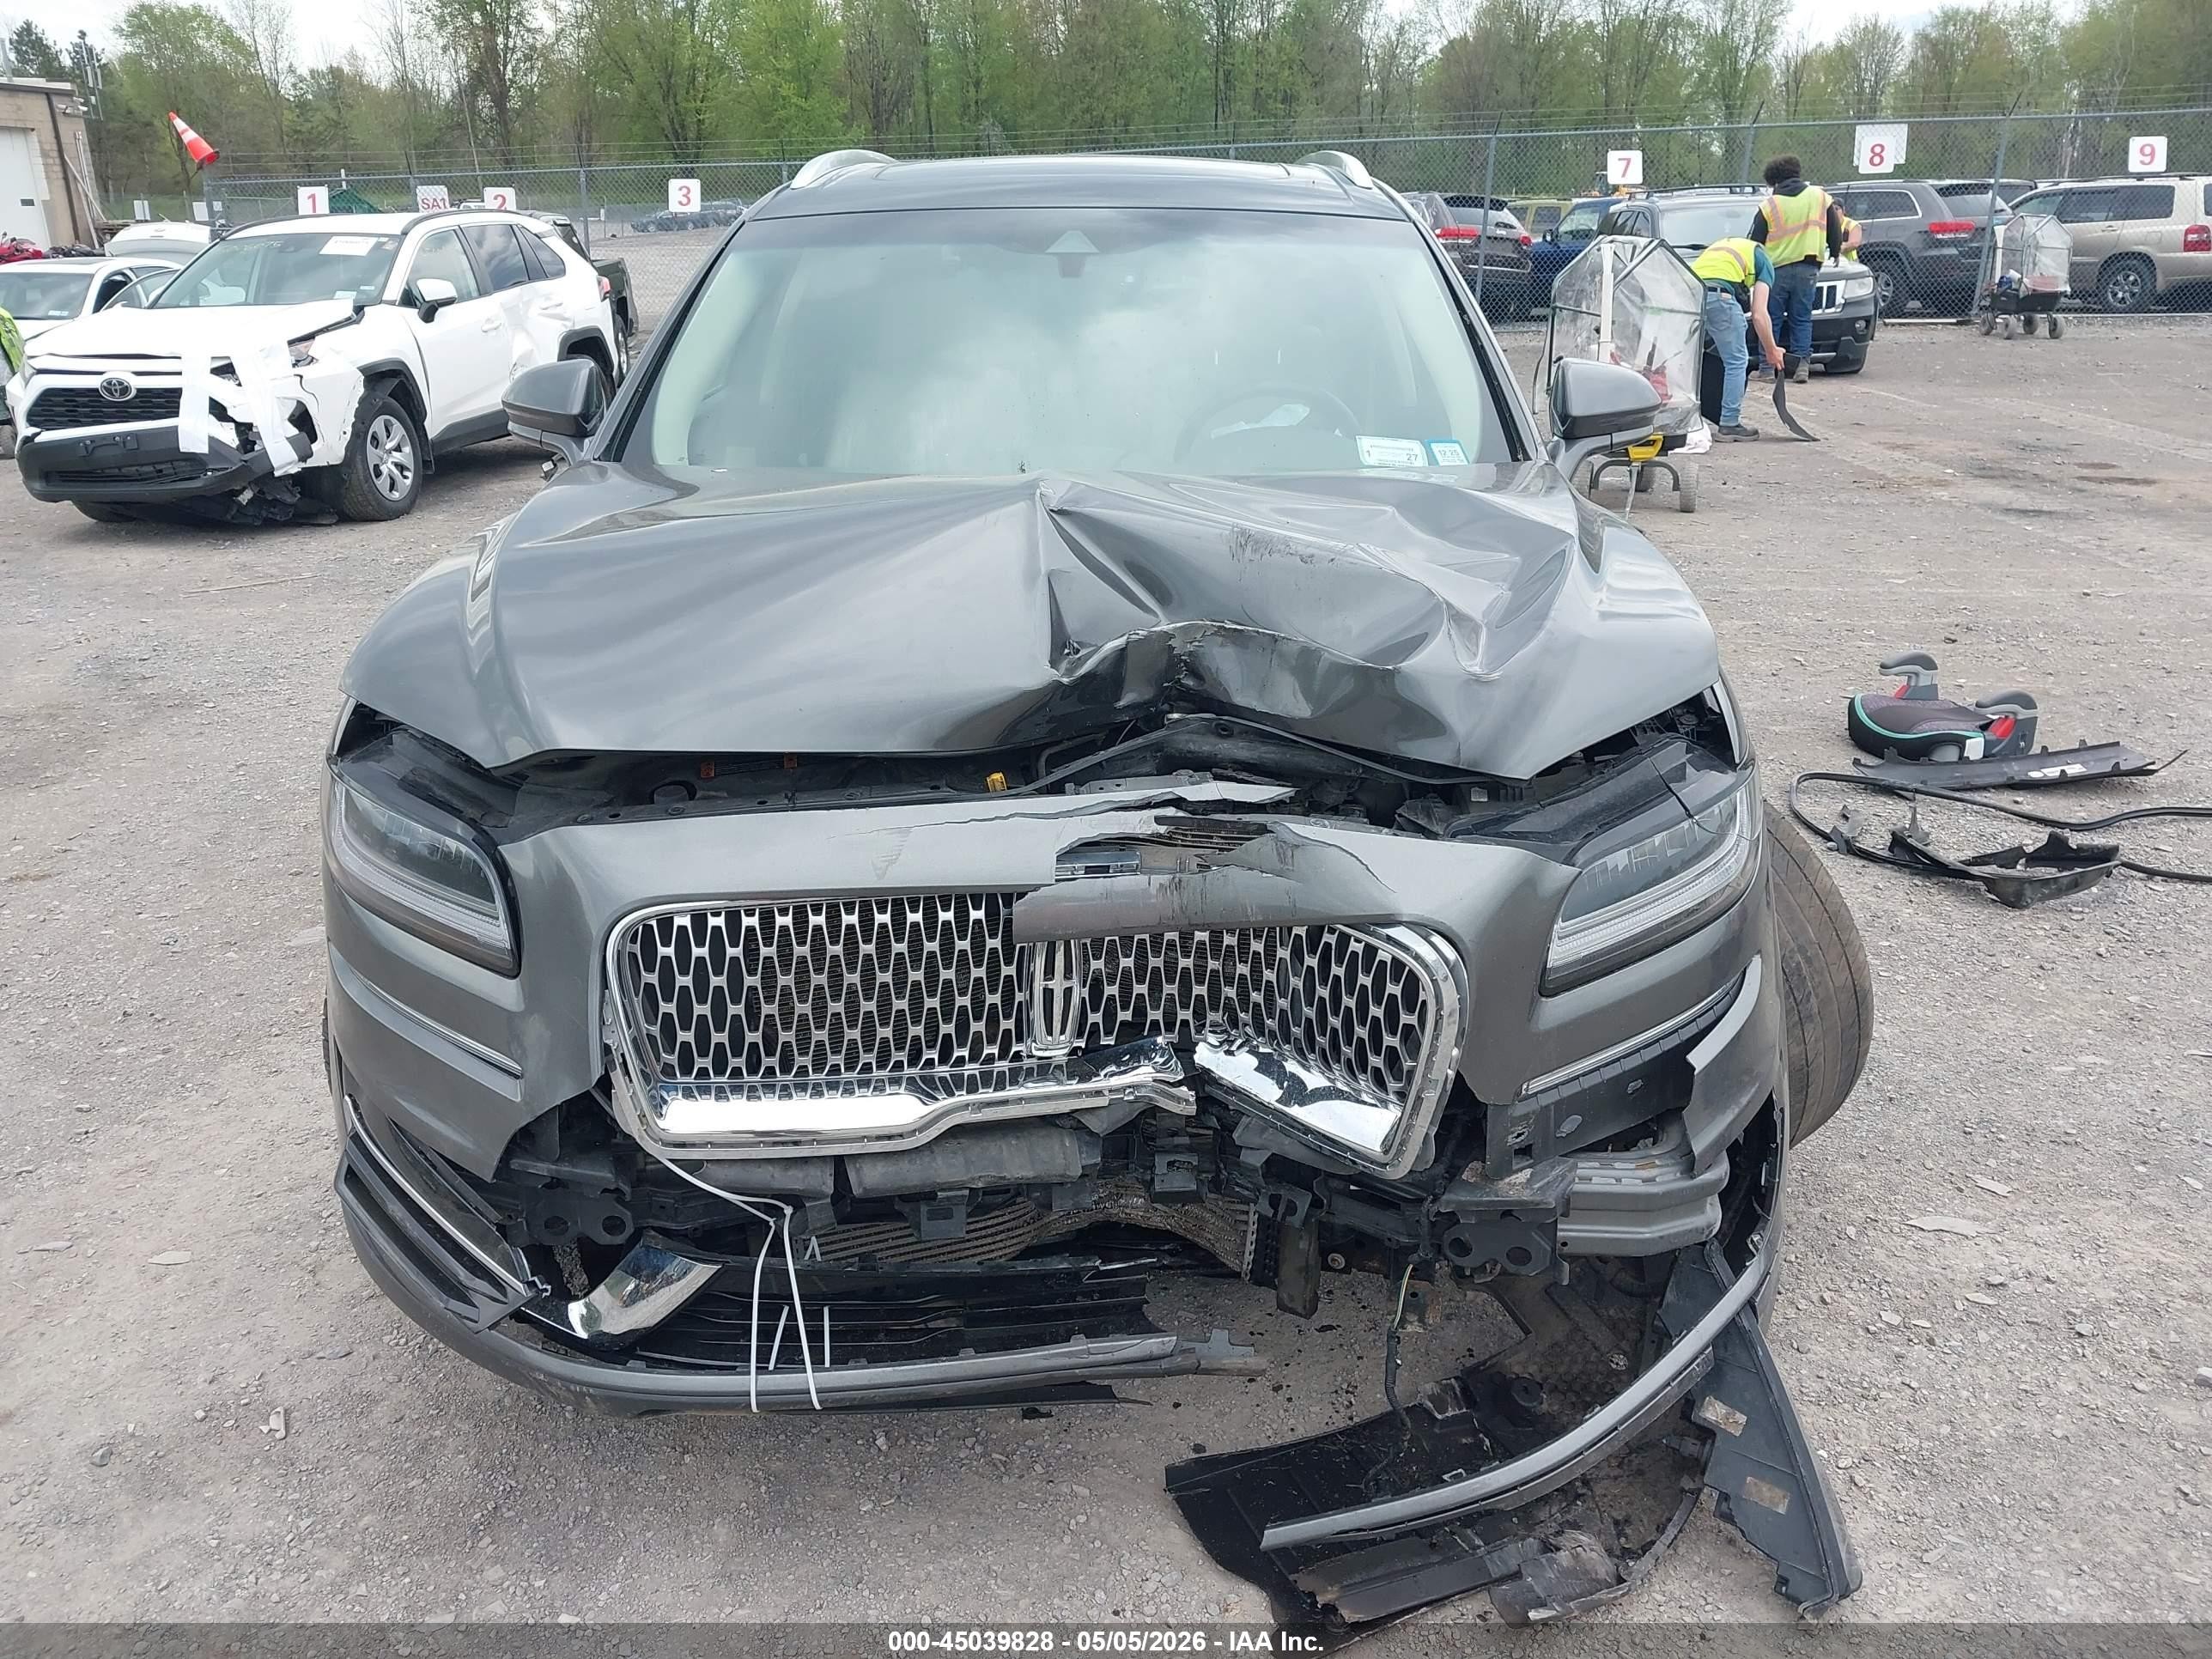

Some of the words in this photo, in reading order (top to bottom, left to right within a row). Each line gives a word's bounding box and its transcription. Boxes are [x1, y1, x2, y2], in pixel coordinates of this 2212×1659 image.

[1868, 143, 1887, 167] 8
[2139, 143, 2156, 166] 9
[1618, 157, 1632, 179] 7
[307, 193, 317, 213] 1
[421, 198, 447, 210] SA1
[493, 193, 507, 210] 2
[678, 185, 691, 207] 3
[1406, 453, 1419, 461] 27
